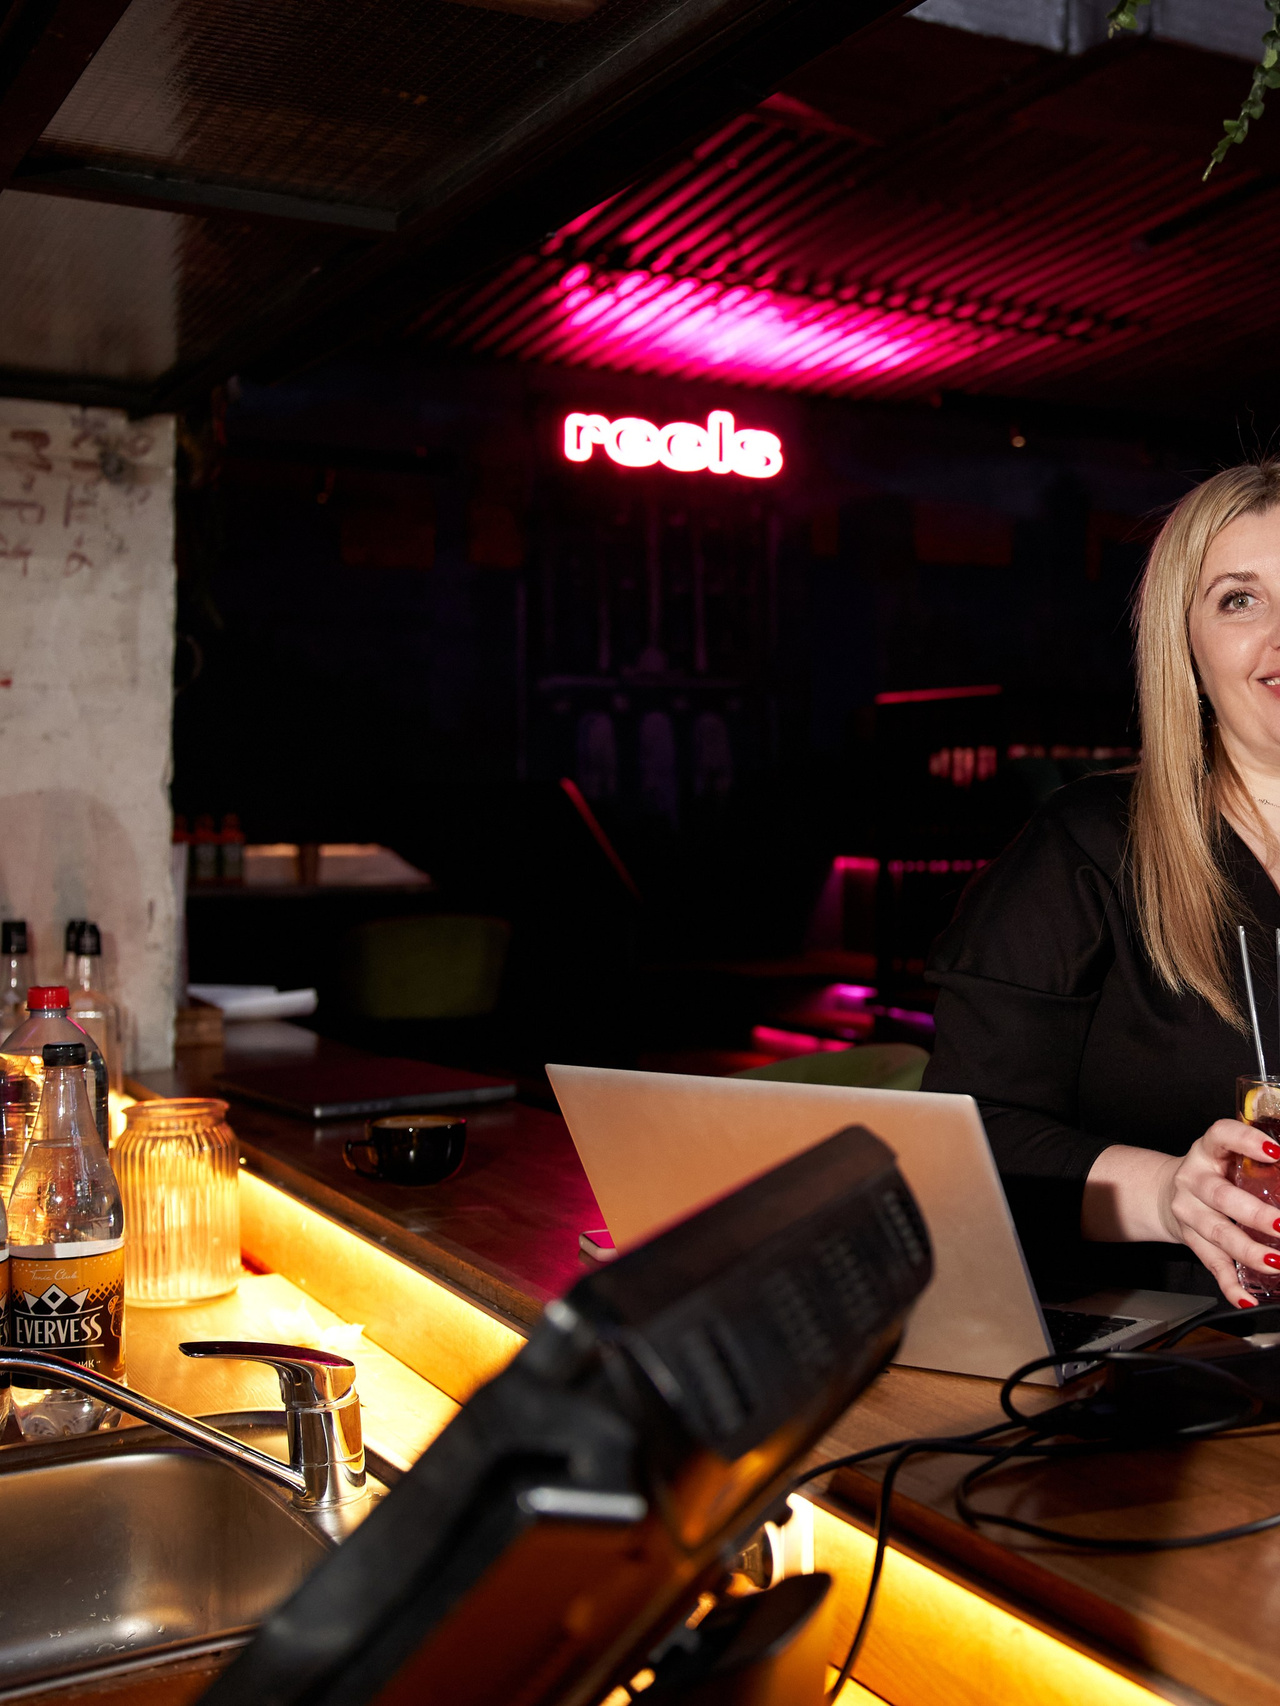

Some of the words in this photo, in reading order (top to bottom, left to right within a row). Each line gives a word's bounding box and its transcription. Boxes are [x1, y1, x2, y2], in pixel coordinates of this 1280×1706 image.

[563, 409, 784, 479] reels
[54, 1268, 79, 1281] Club
[16, 1312, 103, 1345] EVERVESS
